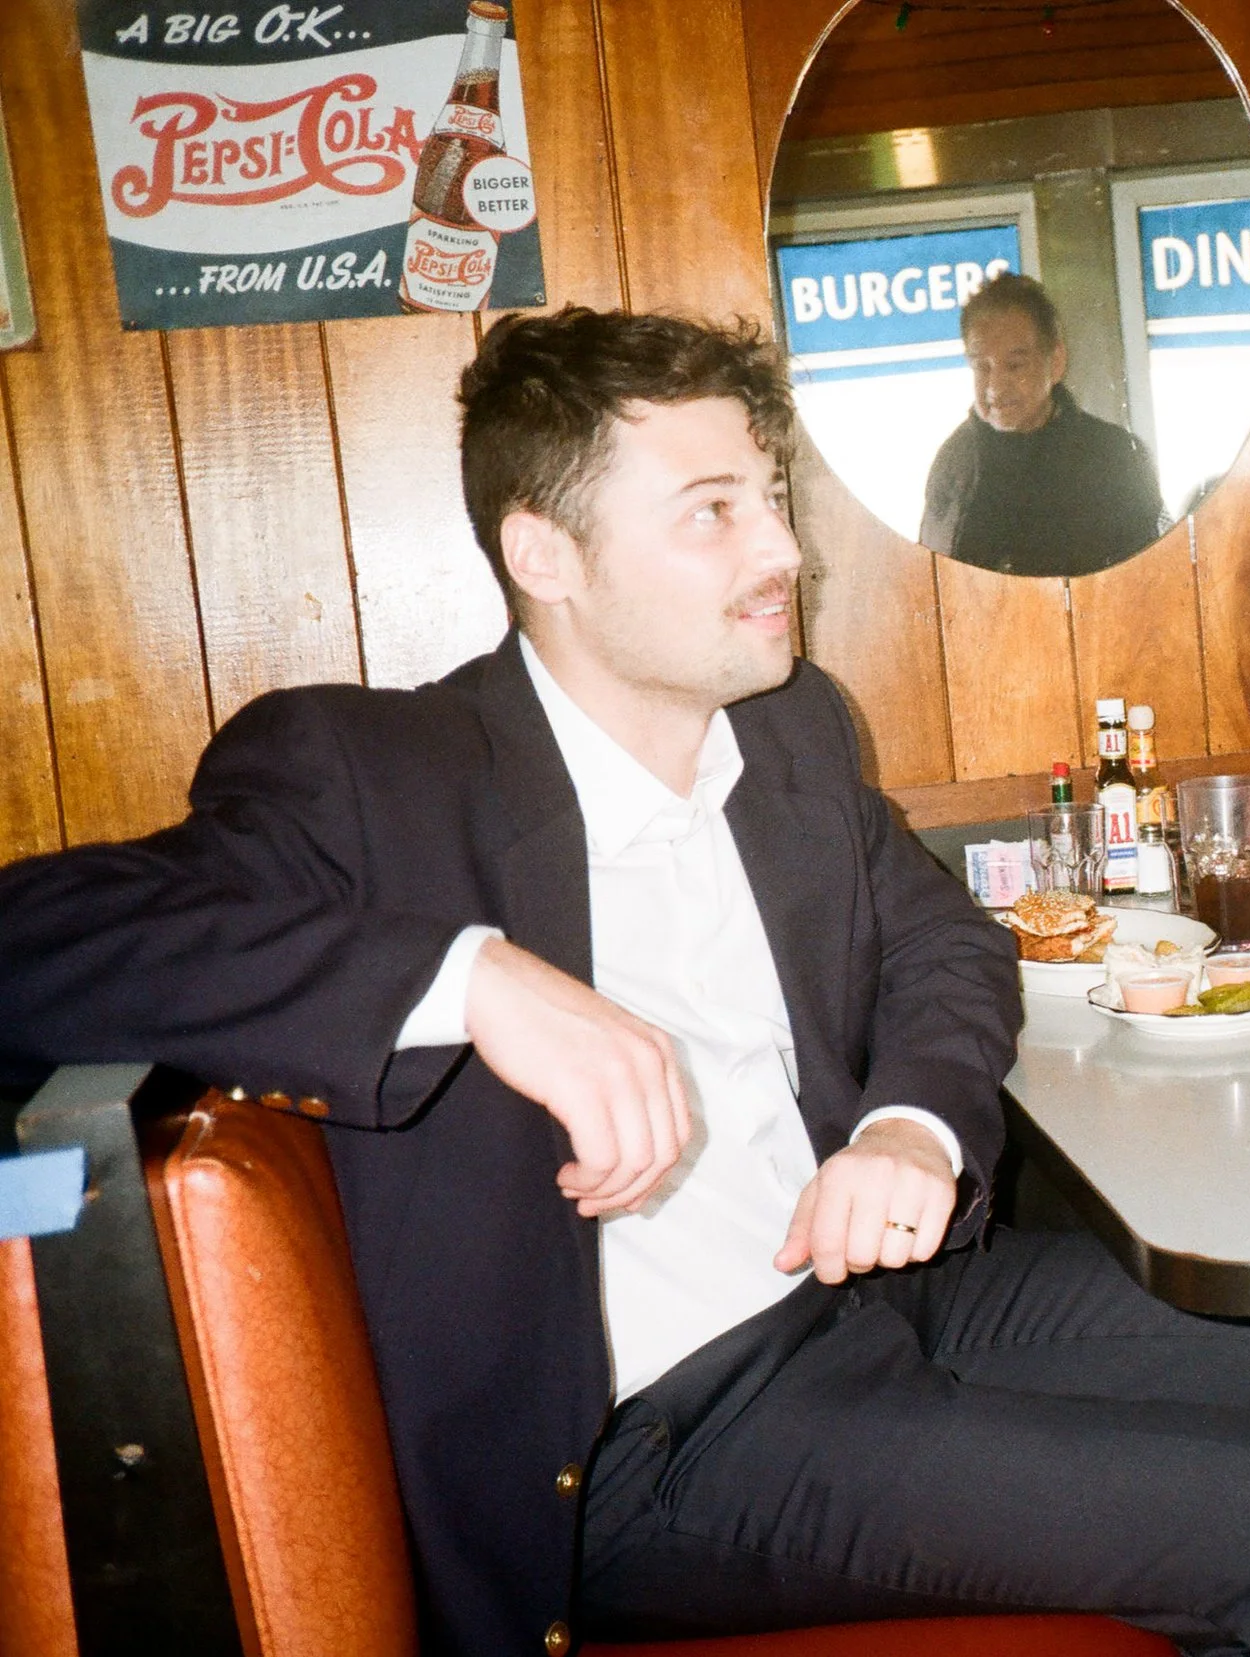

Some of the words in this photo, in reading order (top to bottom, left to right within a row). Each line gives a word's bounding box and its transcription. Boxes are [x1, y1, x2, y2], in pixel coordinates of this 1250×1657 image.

[116, 14, 148, 44] A
[163, 14, 241, 44] BIG
[473, 176, 529, 190] BIGGER
[478, 199, 529, 212] BETTER
[428, 229, 479, 246] SPARKLING
[297, 249, 392, 290] U.S.A.
[419, 283, 471, 299] SATISFYING
